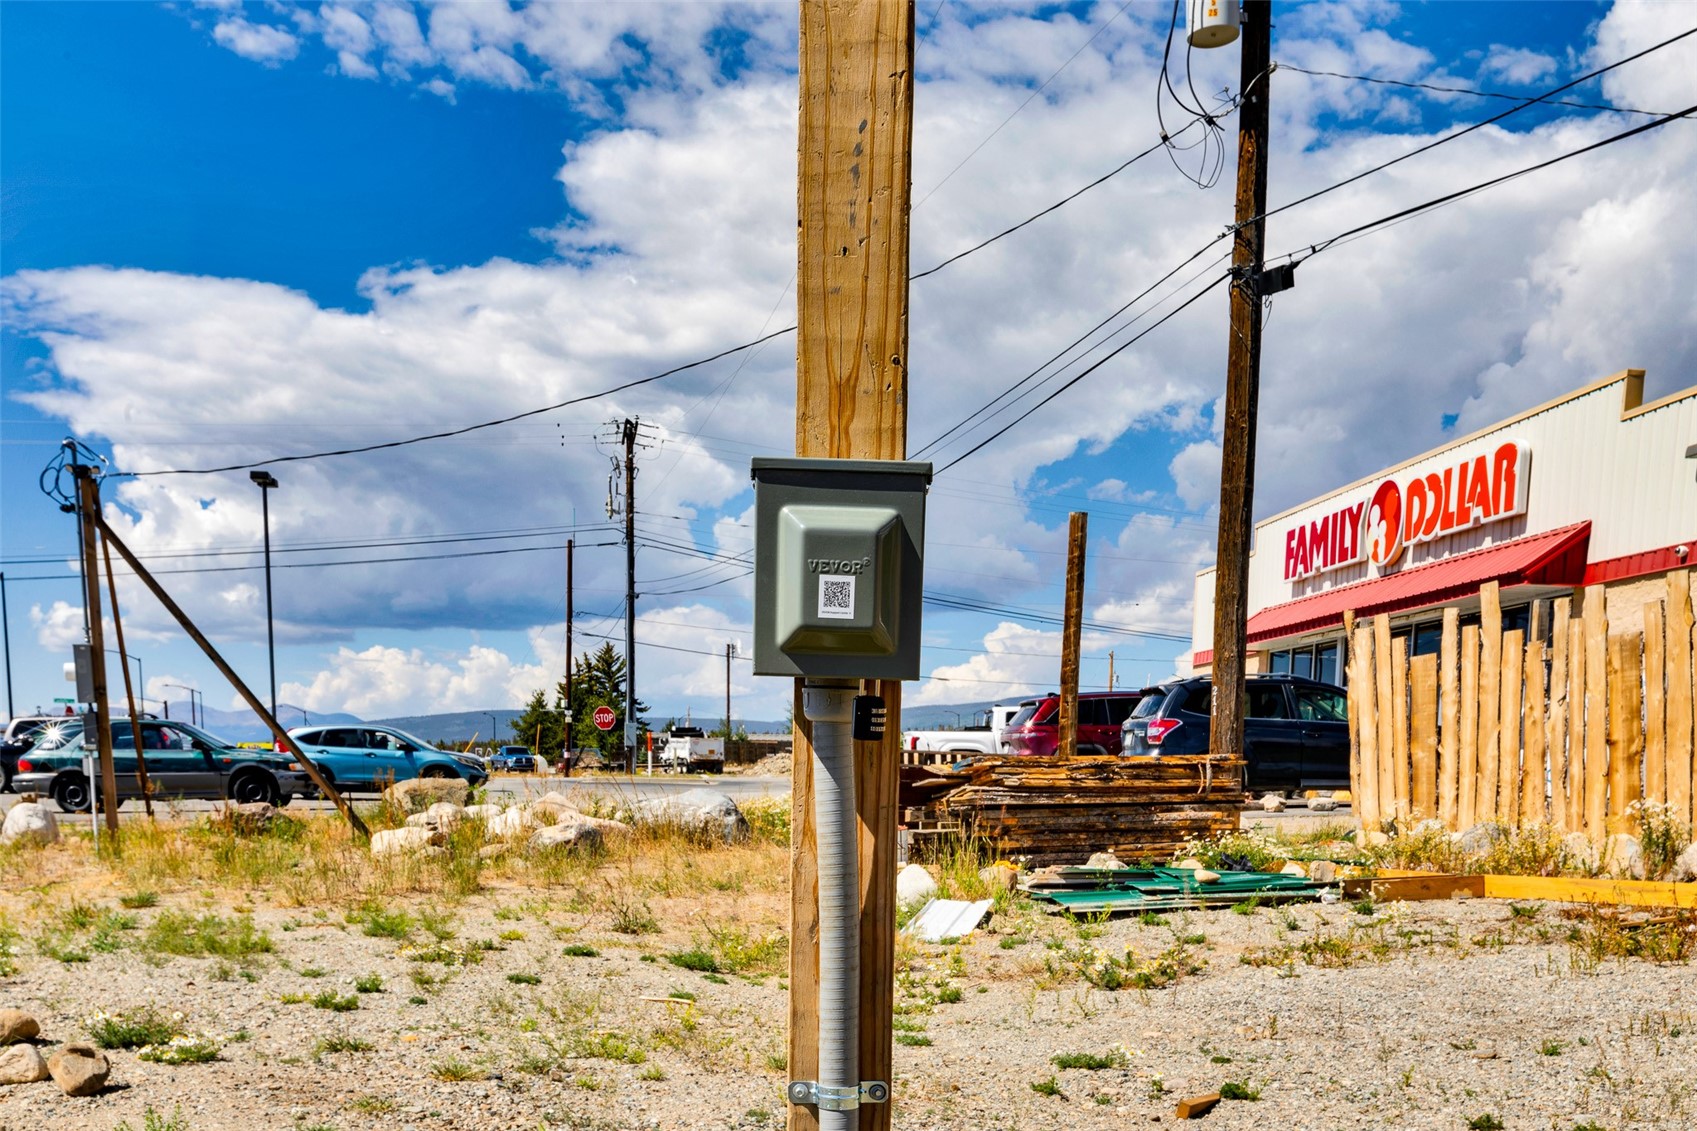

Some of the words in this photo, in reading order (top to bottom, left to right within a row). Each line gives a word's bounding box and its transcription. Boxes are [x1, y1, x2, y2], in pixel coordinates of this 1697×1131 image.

[1284, 500, 1365, 581] FAMILY
[1404, 442, 1518, 541] DOLLAR
[595, 714, 614, 723] STOP
